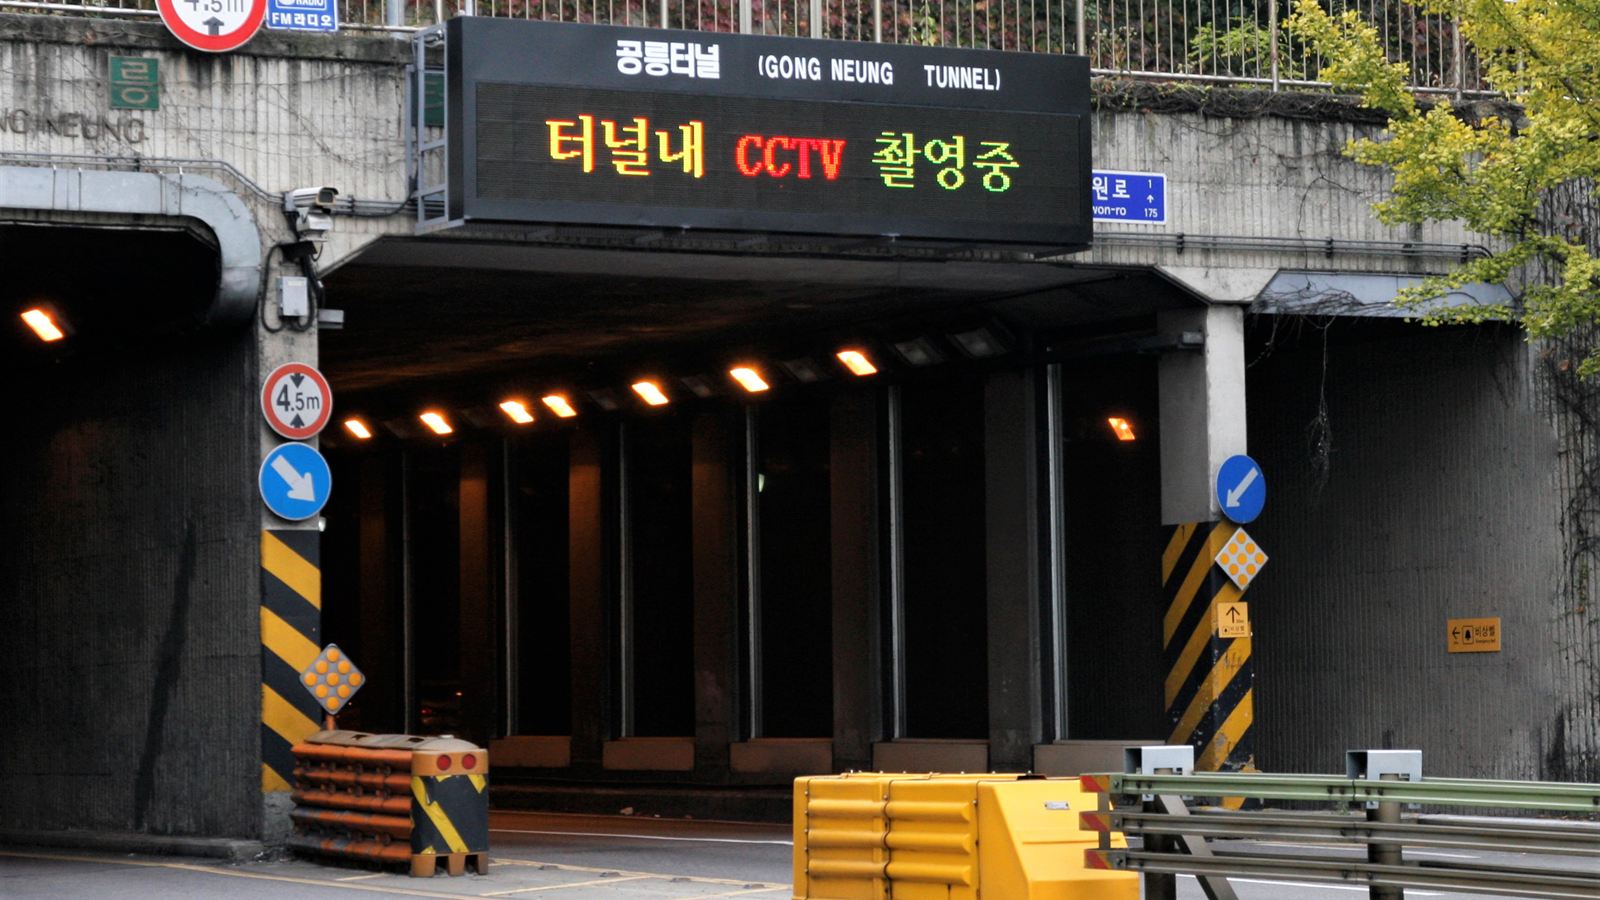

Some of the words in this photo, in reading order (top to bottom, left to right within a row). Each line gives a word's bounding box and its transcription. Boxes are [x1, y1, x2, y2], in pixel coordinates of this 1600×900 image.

[184, 0, 244, 13] .5m
[616, 39, 720, 79] 공릉터널
[758, 55, 821, 81] (GONG
[831, 58, 894, 85] NEUNG
[923, 64, 1001, 91] TUNNEL)
[43, 111, 148, 144] NEUNG
[545, 114, 705, 179] 터널내
[735, 134, 846, 180] CCTV
[871, 131, 1020, 192] 촬영중
[1144, 208, 1158, 218] 175
[276, 384, 320, 412] 4.5m
